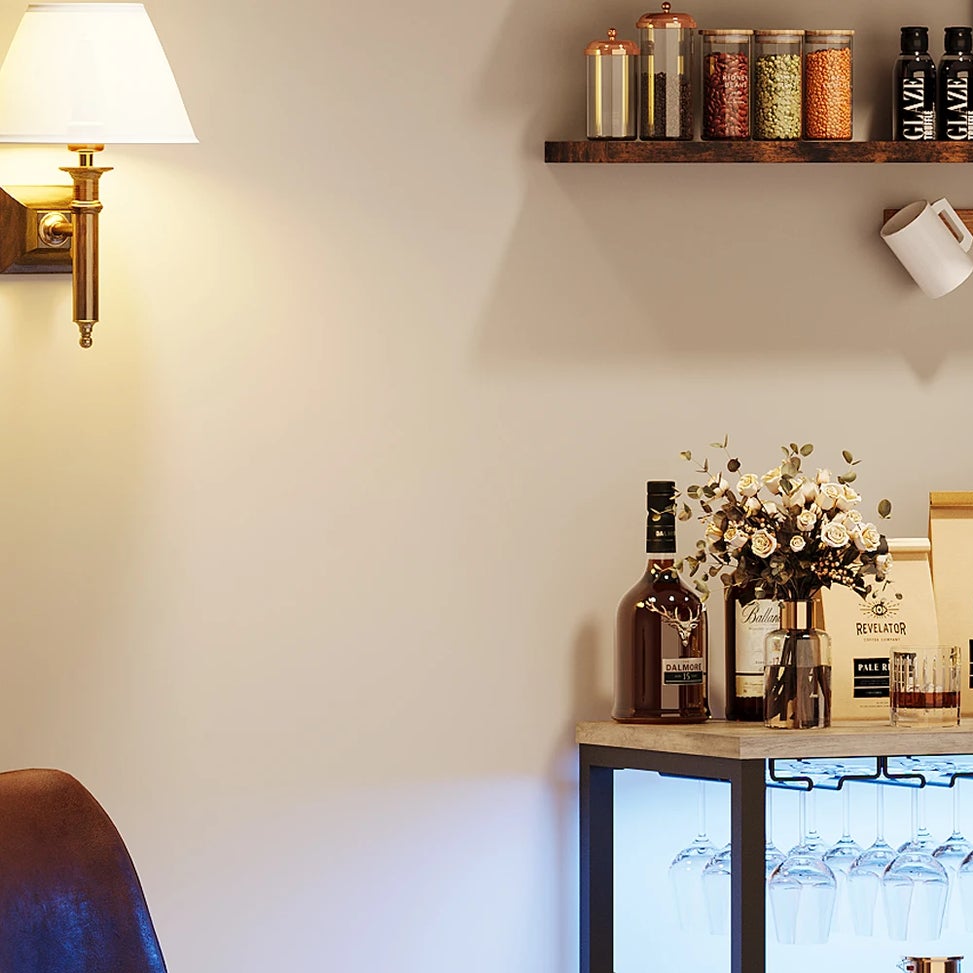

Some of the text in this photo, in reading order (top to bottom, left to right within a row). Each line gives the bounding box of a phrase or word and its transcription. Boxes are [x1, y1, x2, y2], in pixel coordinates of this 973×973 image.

[903, 77, 925, 140] GLAZE
[946, 77, 968, 140] GLAZE
[923, 110, 934, 140] TRUFFLE
[855, 621, 907, 636] REVELATOR
[665, 662, 702, 672] DALMORE
[857, 662, 880, 672] PALE
[682, 671, 692, 681] 15
